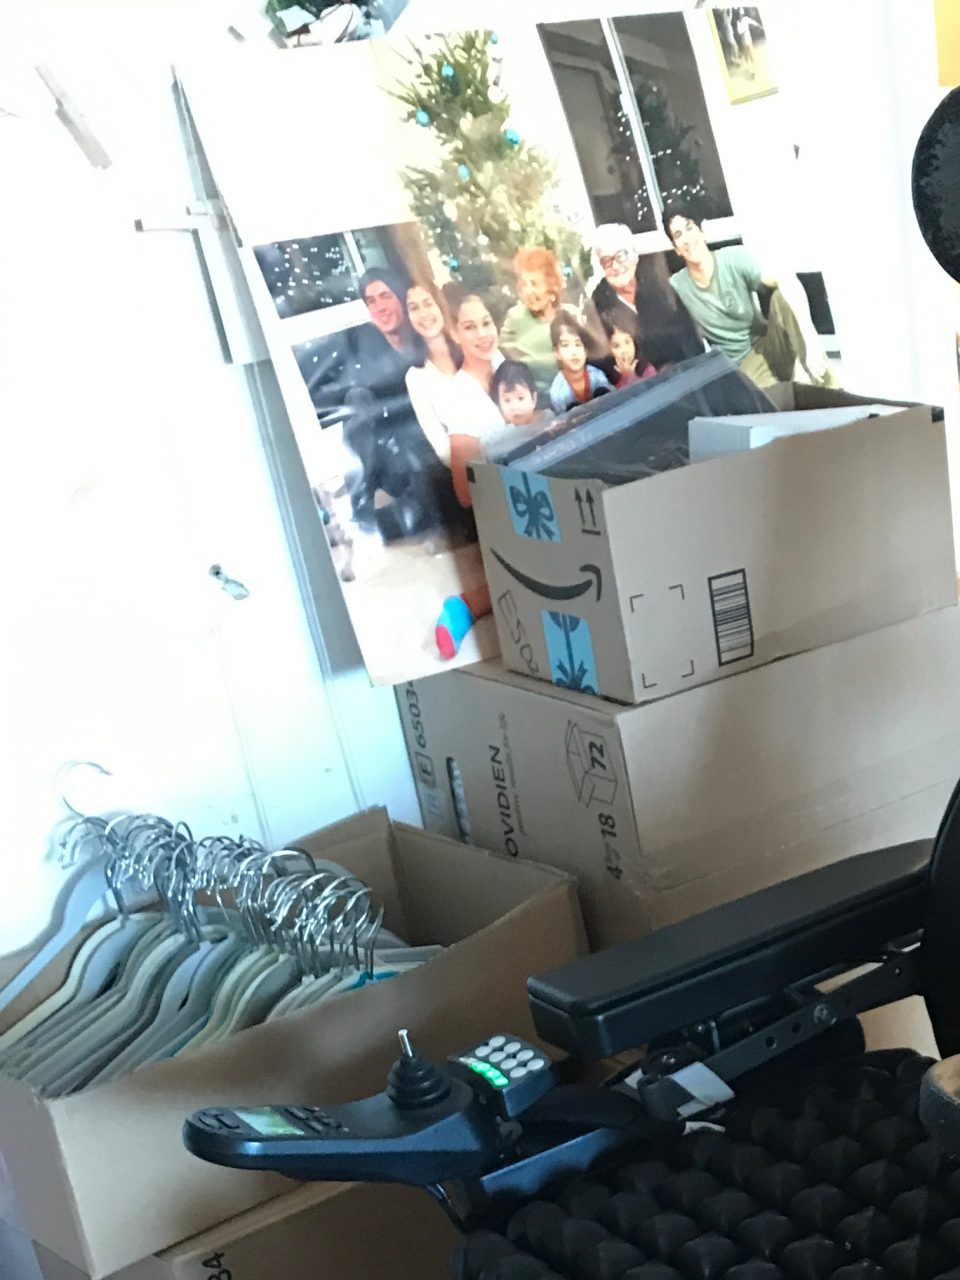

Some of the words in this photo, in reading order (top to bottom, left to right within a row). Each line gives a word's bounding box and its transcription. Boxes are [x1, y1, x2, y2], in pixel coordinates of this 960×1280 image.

[589, 741, 607, 771] 72
[489, 744, 519, 857] OVIDIEN
[598, 813, 618, 839] 18
[606, 864, 623, 880] 4
